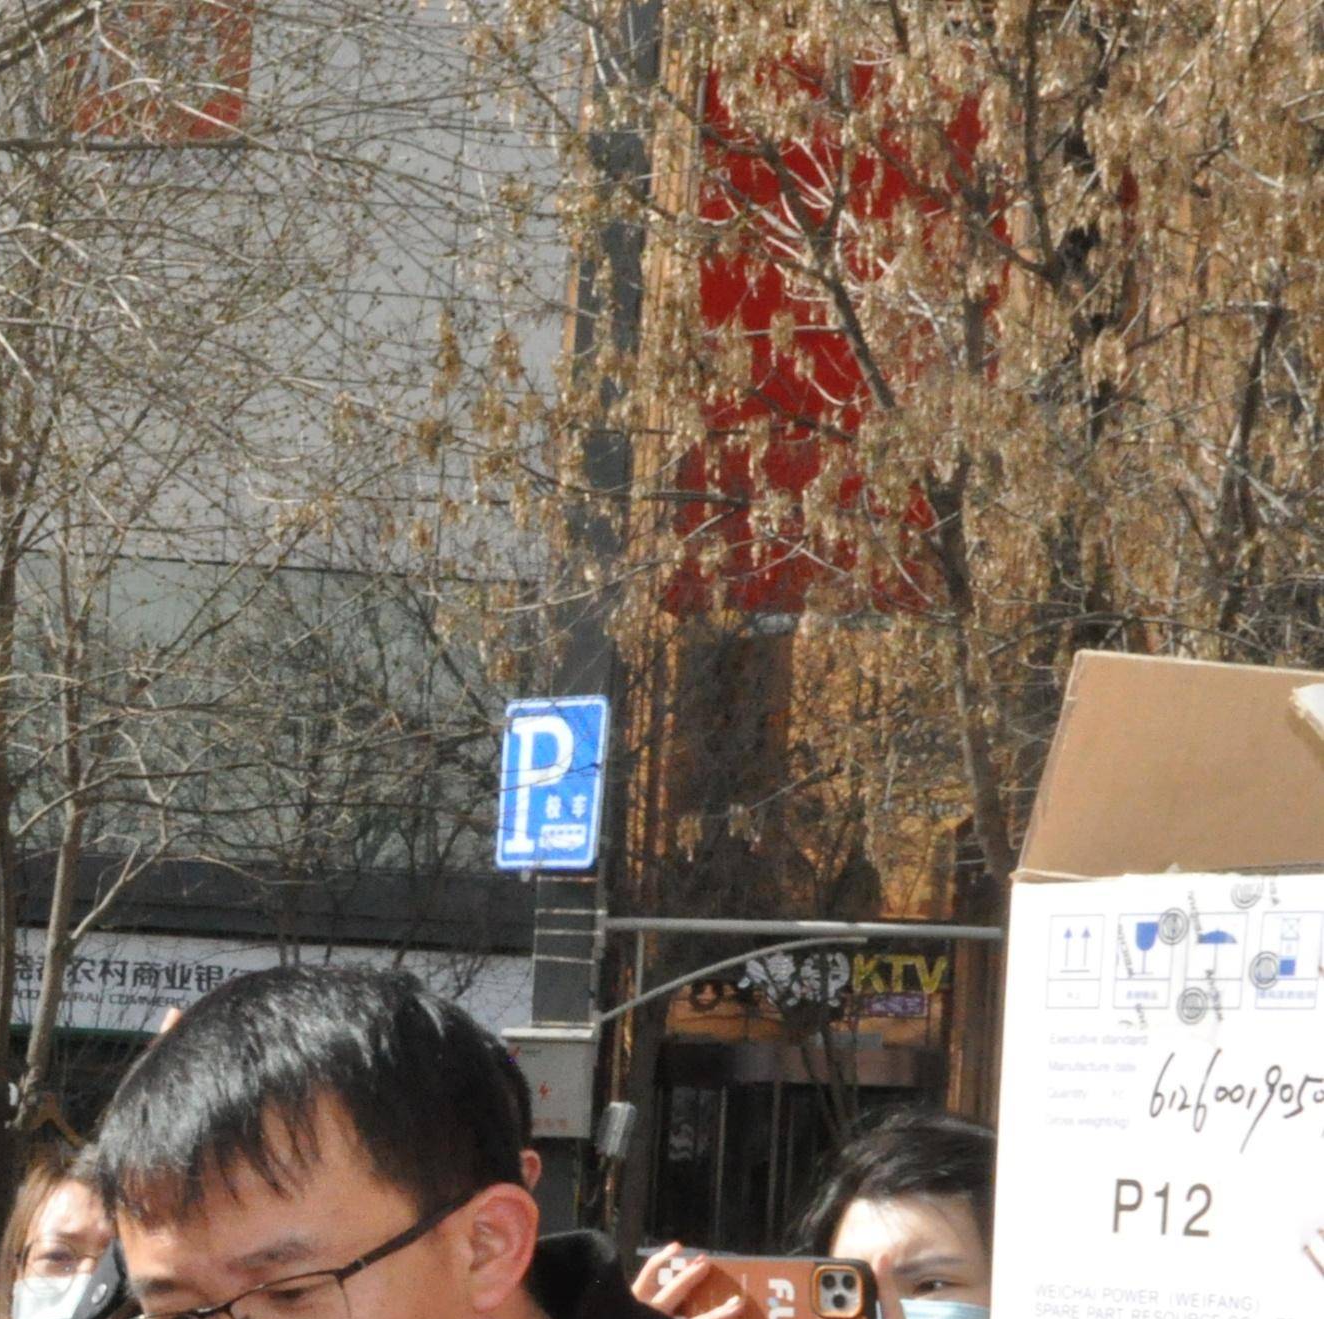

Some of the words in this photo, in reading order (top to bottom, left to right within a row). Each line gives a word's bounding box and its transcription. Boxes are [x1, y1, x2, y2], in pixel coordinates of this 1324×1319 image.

[504, 715, 574, 853] P
[852, 953, 948, 993] KTV
[1113, 1178, 1215, 1239] P12
[1034, 1302, 1080, 1319] SPARE
[1035, 1284, 1097, 1301] WEICHAI
[1102, 1287, 1160, 1305] POWER
[1169, 1292, 1261, 1314] (WEIFANG)
